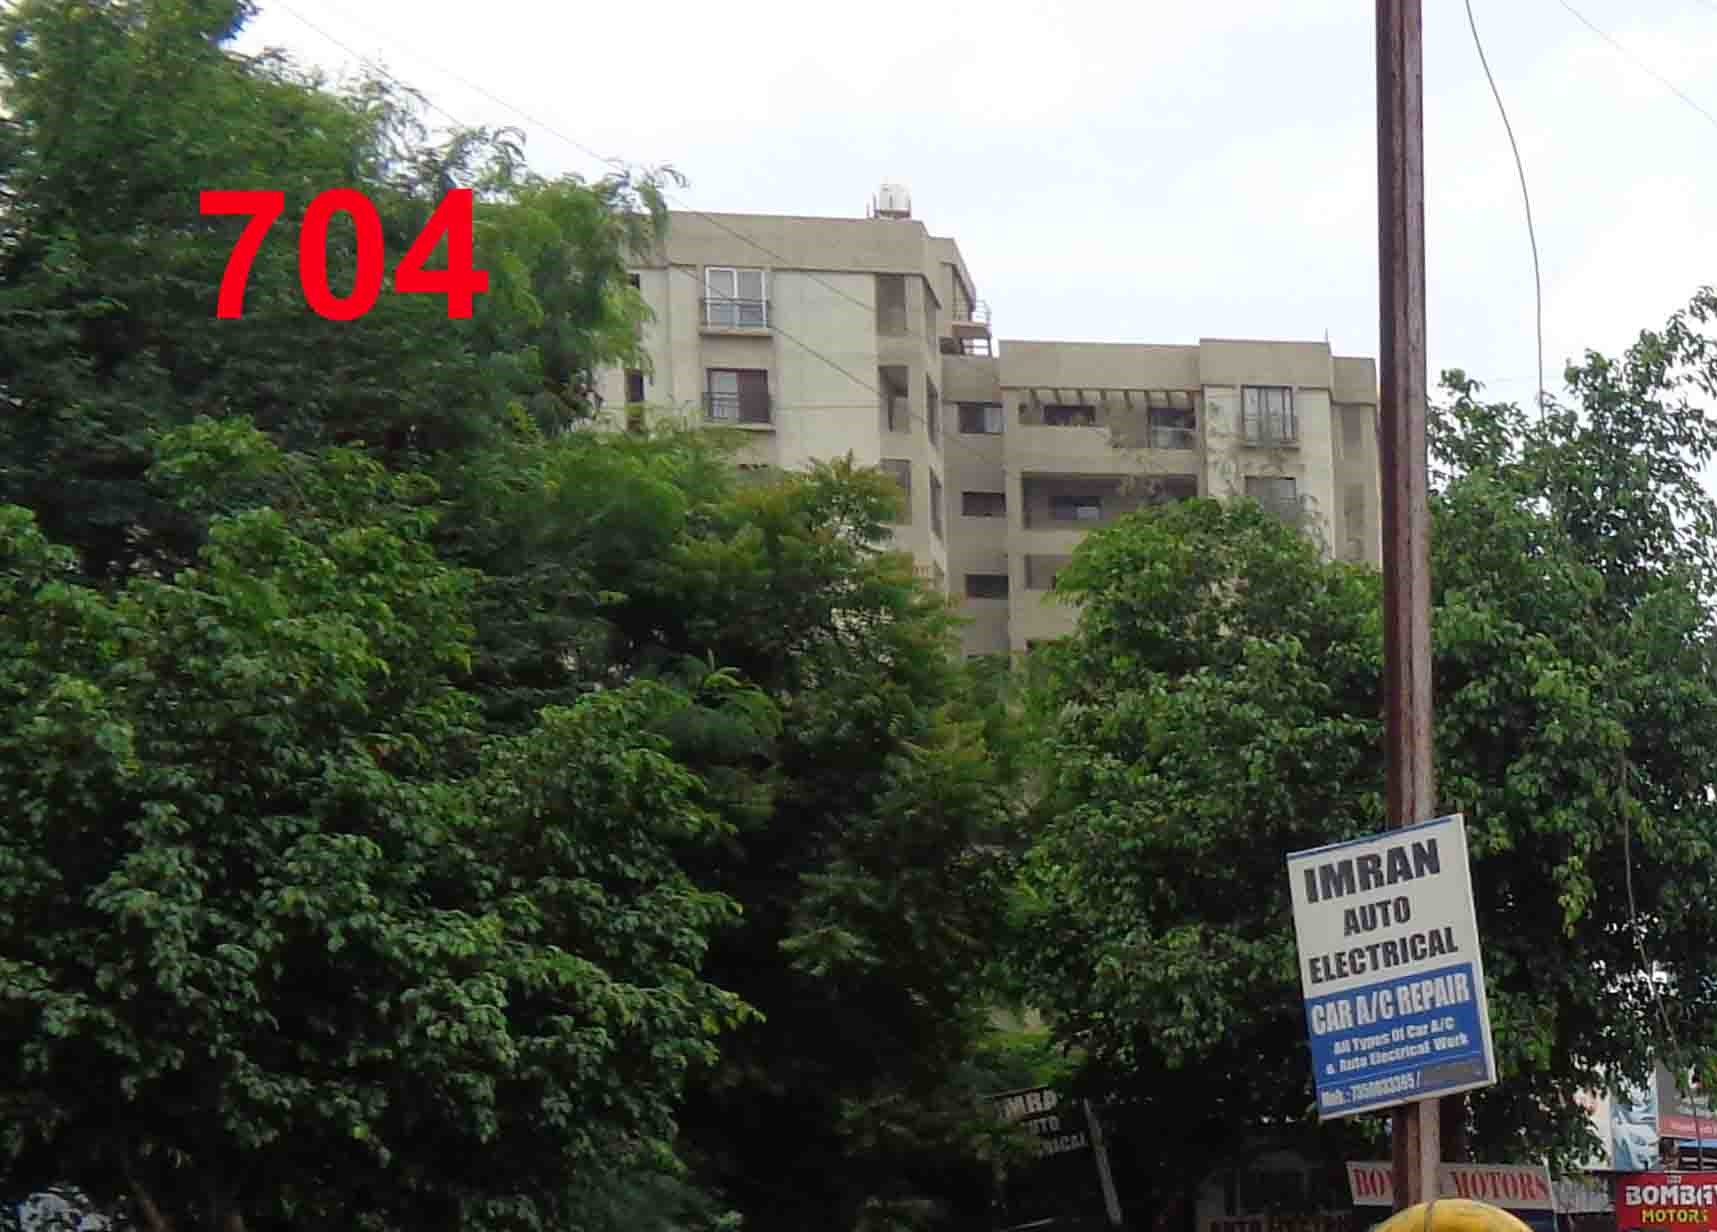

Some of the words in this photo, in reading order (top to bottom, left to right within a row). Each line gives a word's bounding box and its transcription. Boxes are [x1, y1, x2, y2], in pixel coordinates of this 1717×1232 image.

[1303, 837, 1441, 904] IMRAN
[1343, 895, 1411, 937] AUTO
[1309, 926, 1459, 984] ELECTRICAL
[1311, 998, 1353, 1036] CAR
[1356, 988, 1395, 1026] A/C
[1396, 972, 1470, 1016] REPAIR
[1352, 1031, 1391, 1051] Types
[1450, 1169, 1551, 1200] MOTORS
[1641, 1209, 1710, 1224] MOTORS
